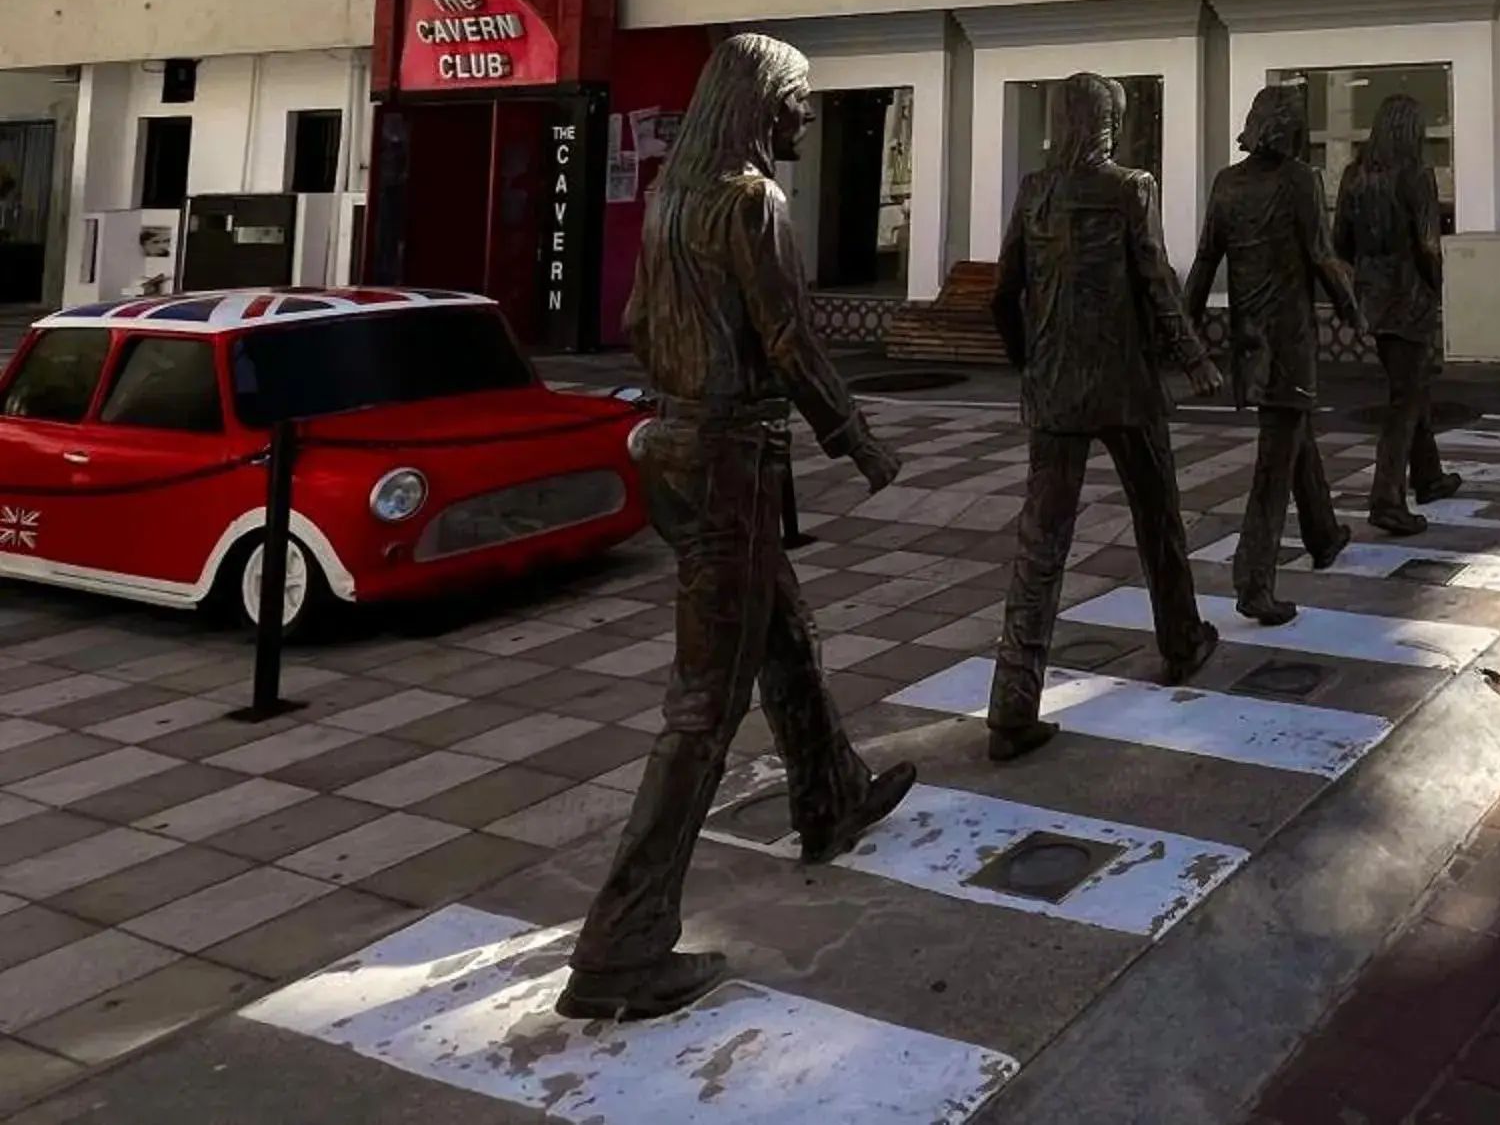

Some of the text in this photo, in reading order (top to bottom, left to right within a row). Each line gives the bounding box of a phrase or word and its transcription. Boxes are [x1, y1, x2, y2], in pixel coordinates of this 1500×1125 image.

[416, 13, 522, 45] CAVERN
[438, 51, 508, 80] CLUB
[552, 125, 575, 141] THE
[549, 144, 569, 310] CAVERN
